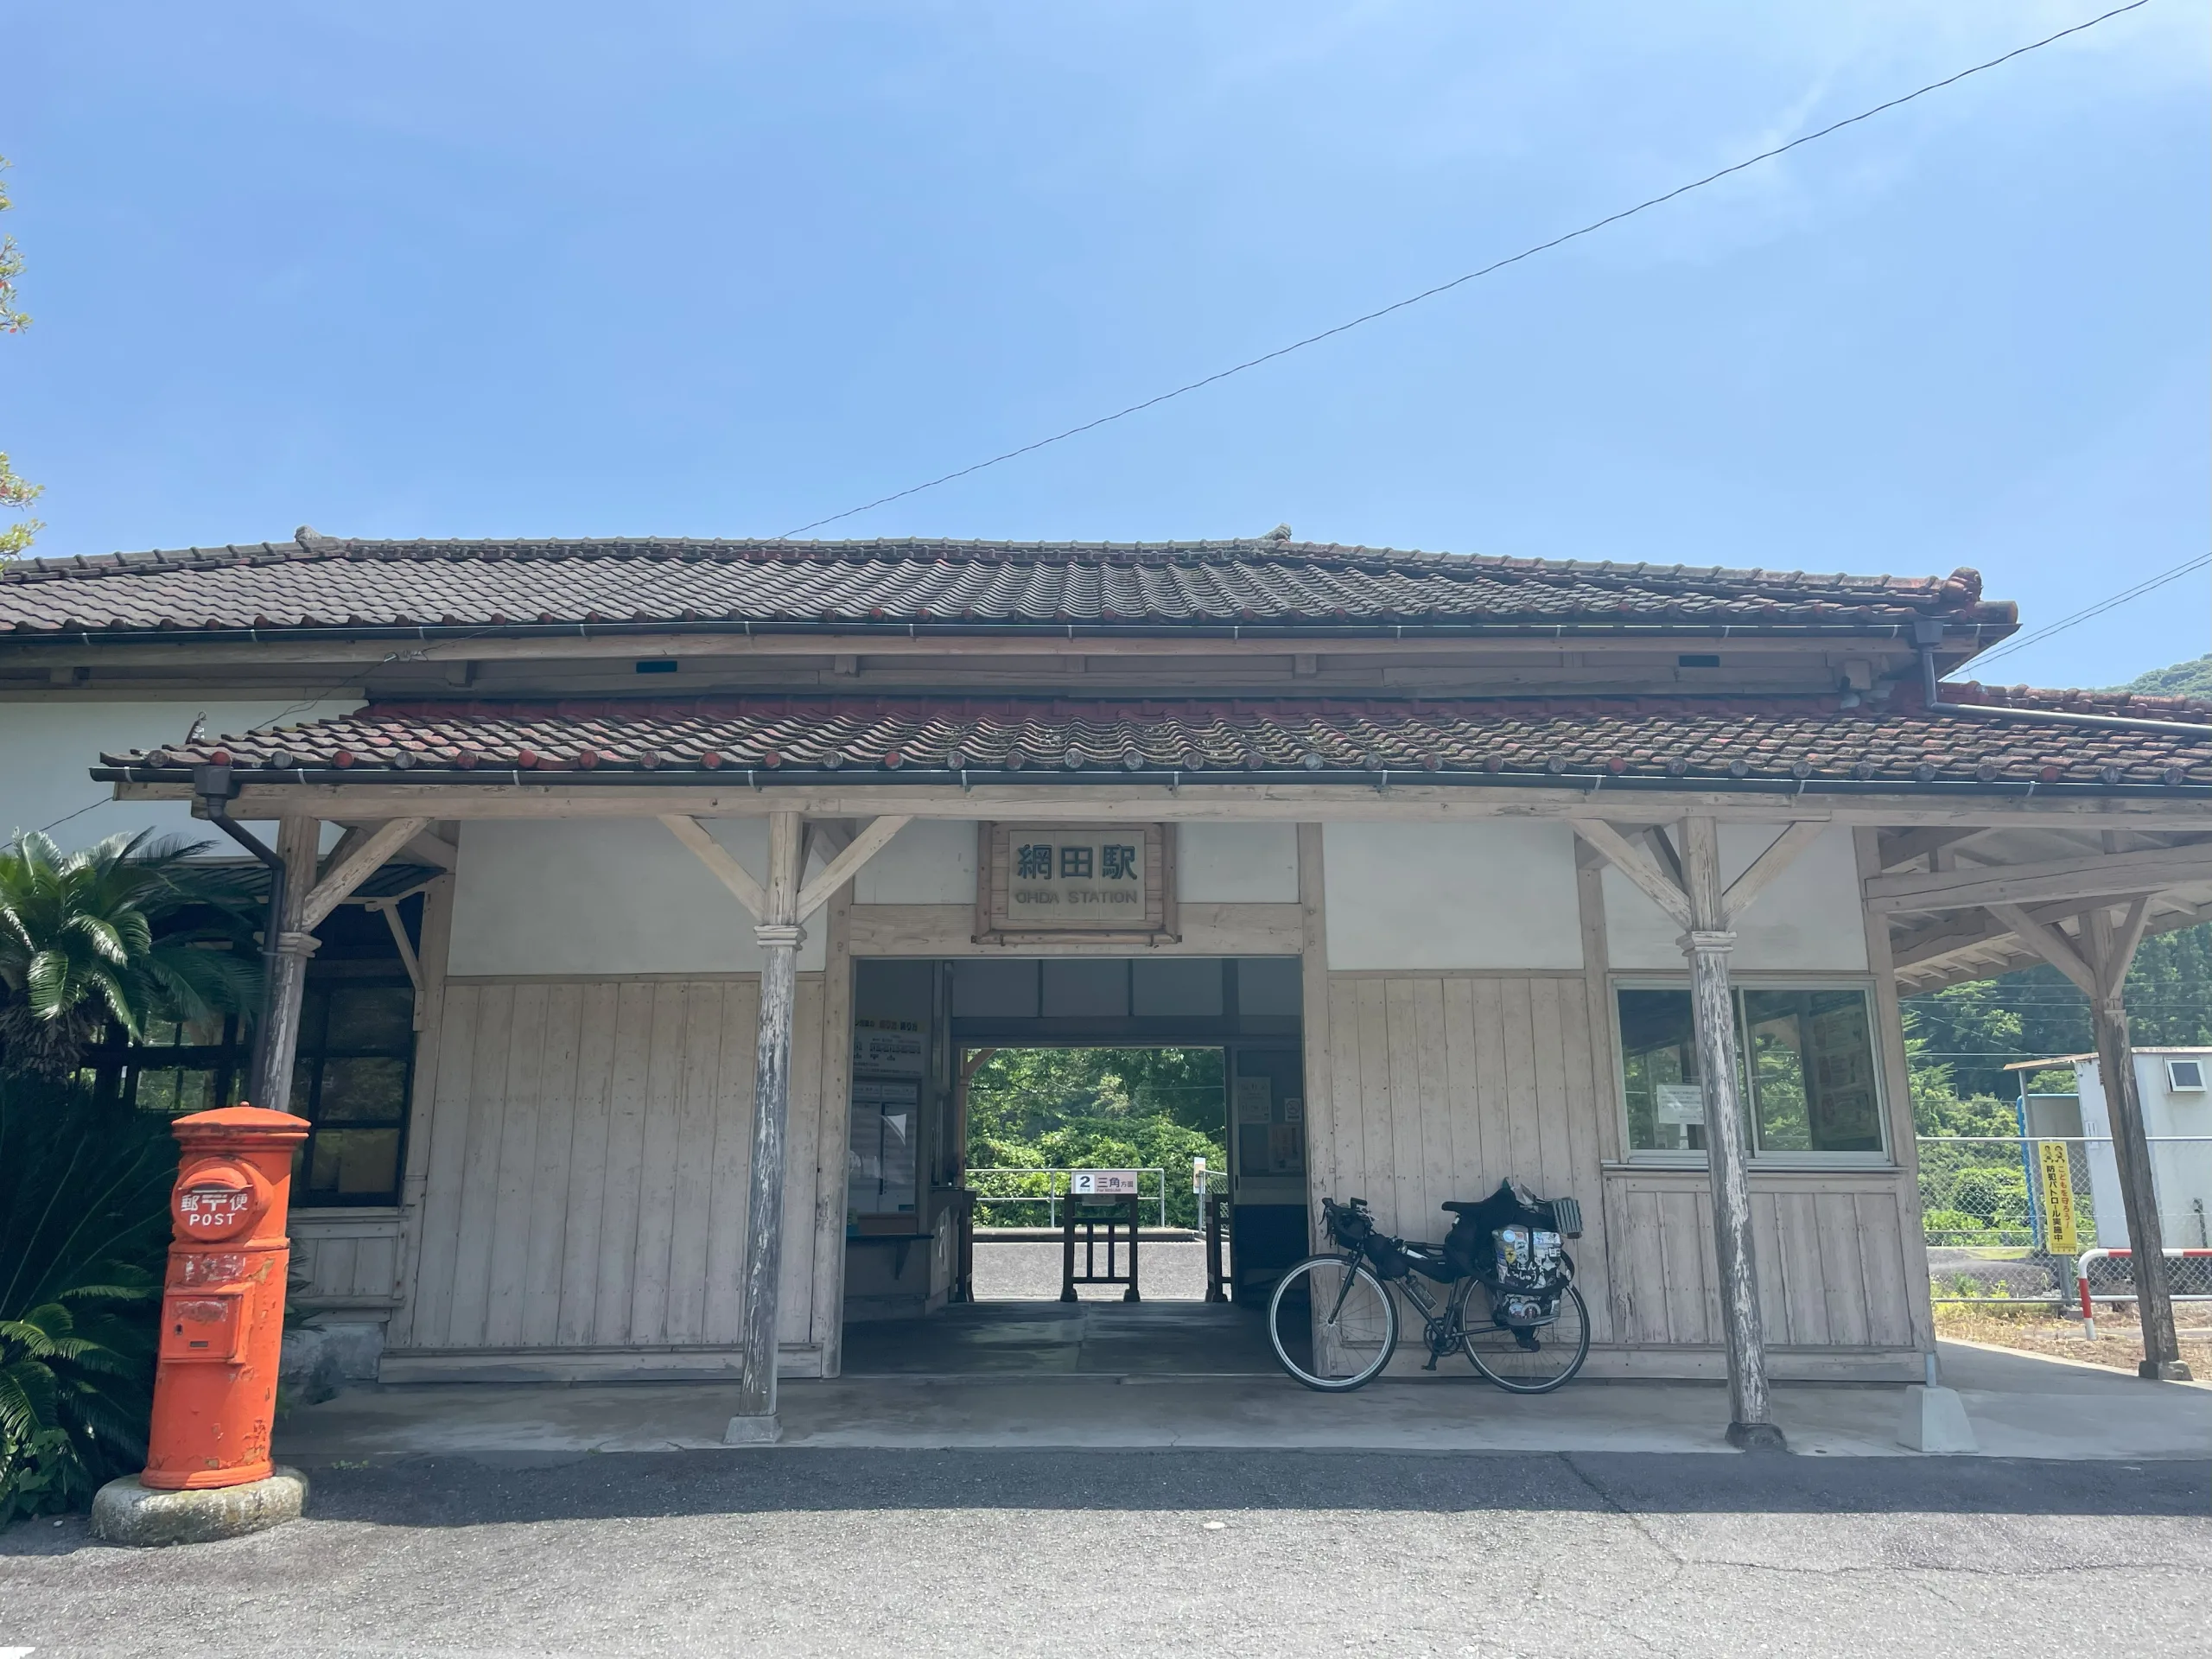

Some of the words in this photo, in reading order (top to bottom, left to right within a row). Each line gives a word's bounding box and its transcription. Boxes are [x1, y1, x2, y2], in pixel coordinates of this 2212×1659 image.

[1017, 843, 1137, 880] 網田駅
[1015, 891, 1058, 904] OHDA
[1068, 891, 1137, 904] STATION
[1079, 1176, 1090, 1187] 2
[2046, 1165, 2063, 1242] 防犯パトロール実施中
[189, 1213, 236, 1226] POST
